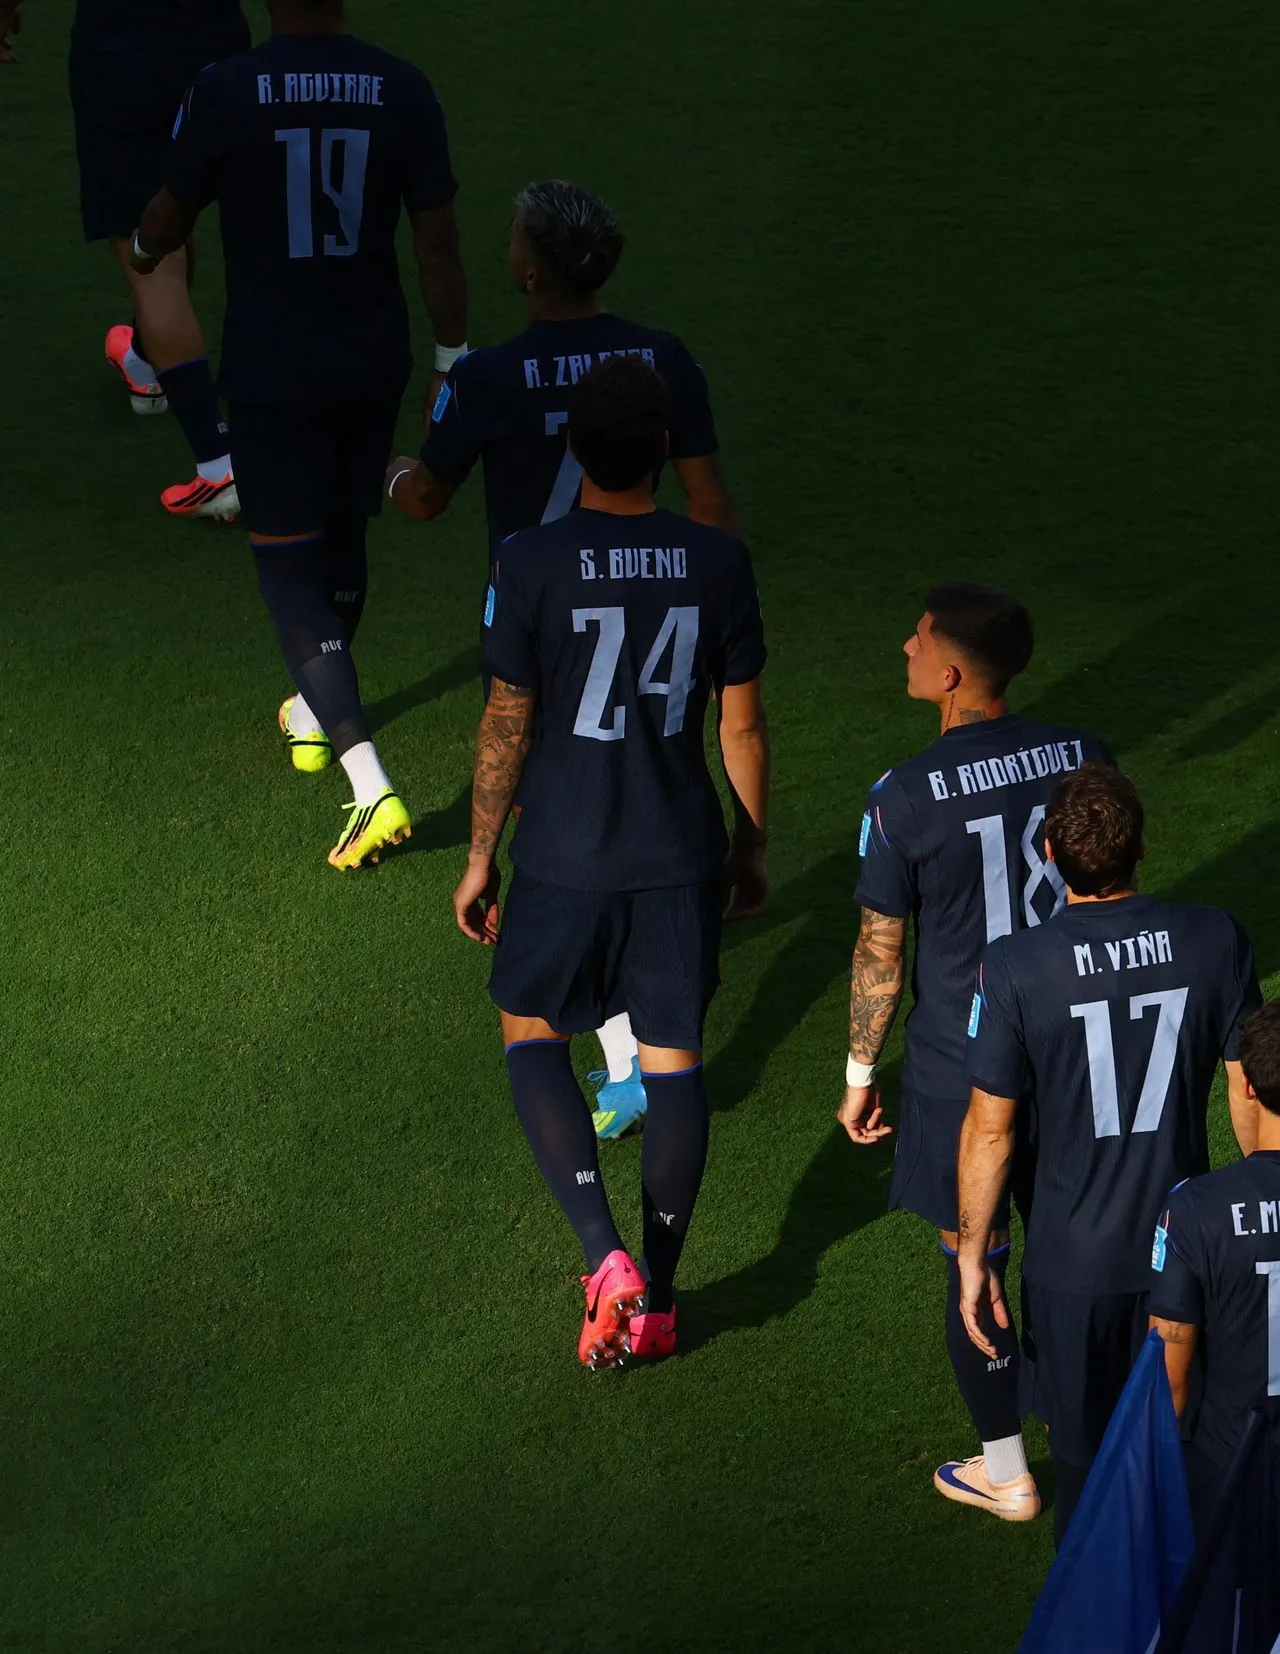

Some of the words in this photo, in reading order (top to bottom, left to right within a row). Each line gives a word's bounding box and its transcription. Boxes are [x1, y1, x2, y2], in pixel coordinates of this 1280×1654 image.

[273, 127, 371, 259] 19
[319, 639, 344, 654] AUF
[571, 605, 701, 743] 24
[964, 804, 1068, 946] 18
[1069, 986, 1190, 1139] 17
[575, 1170, 596, 1186] AUF
[986, 1355, 1012, 1372] AUF
